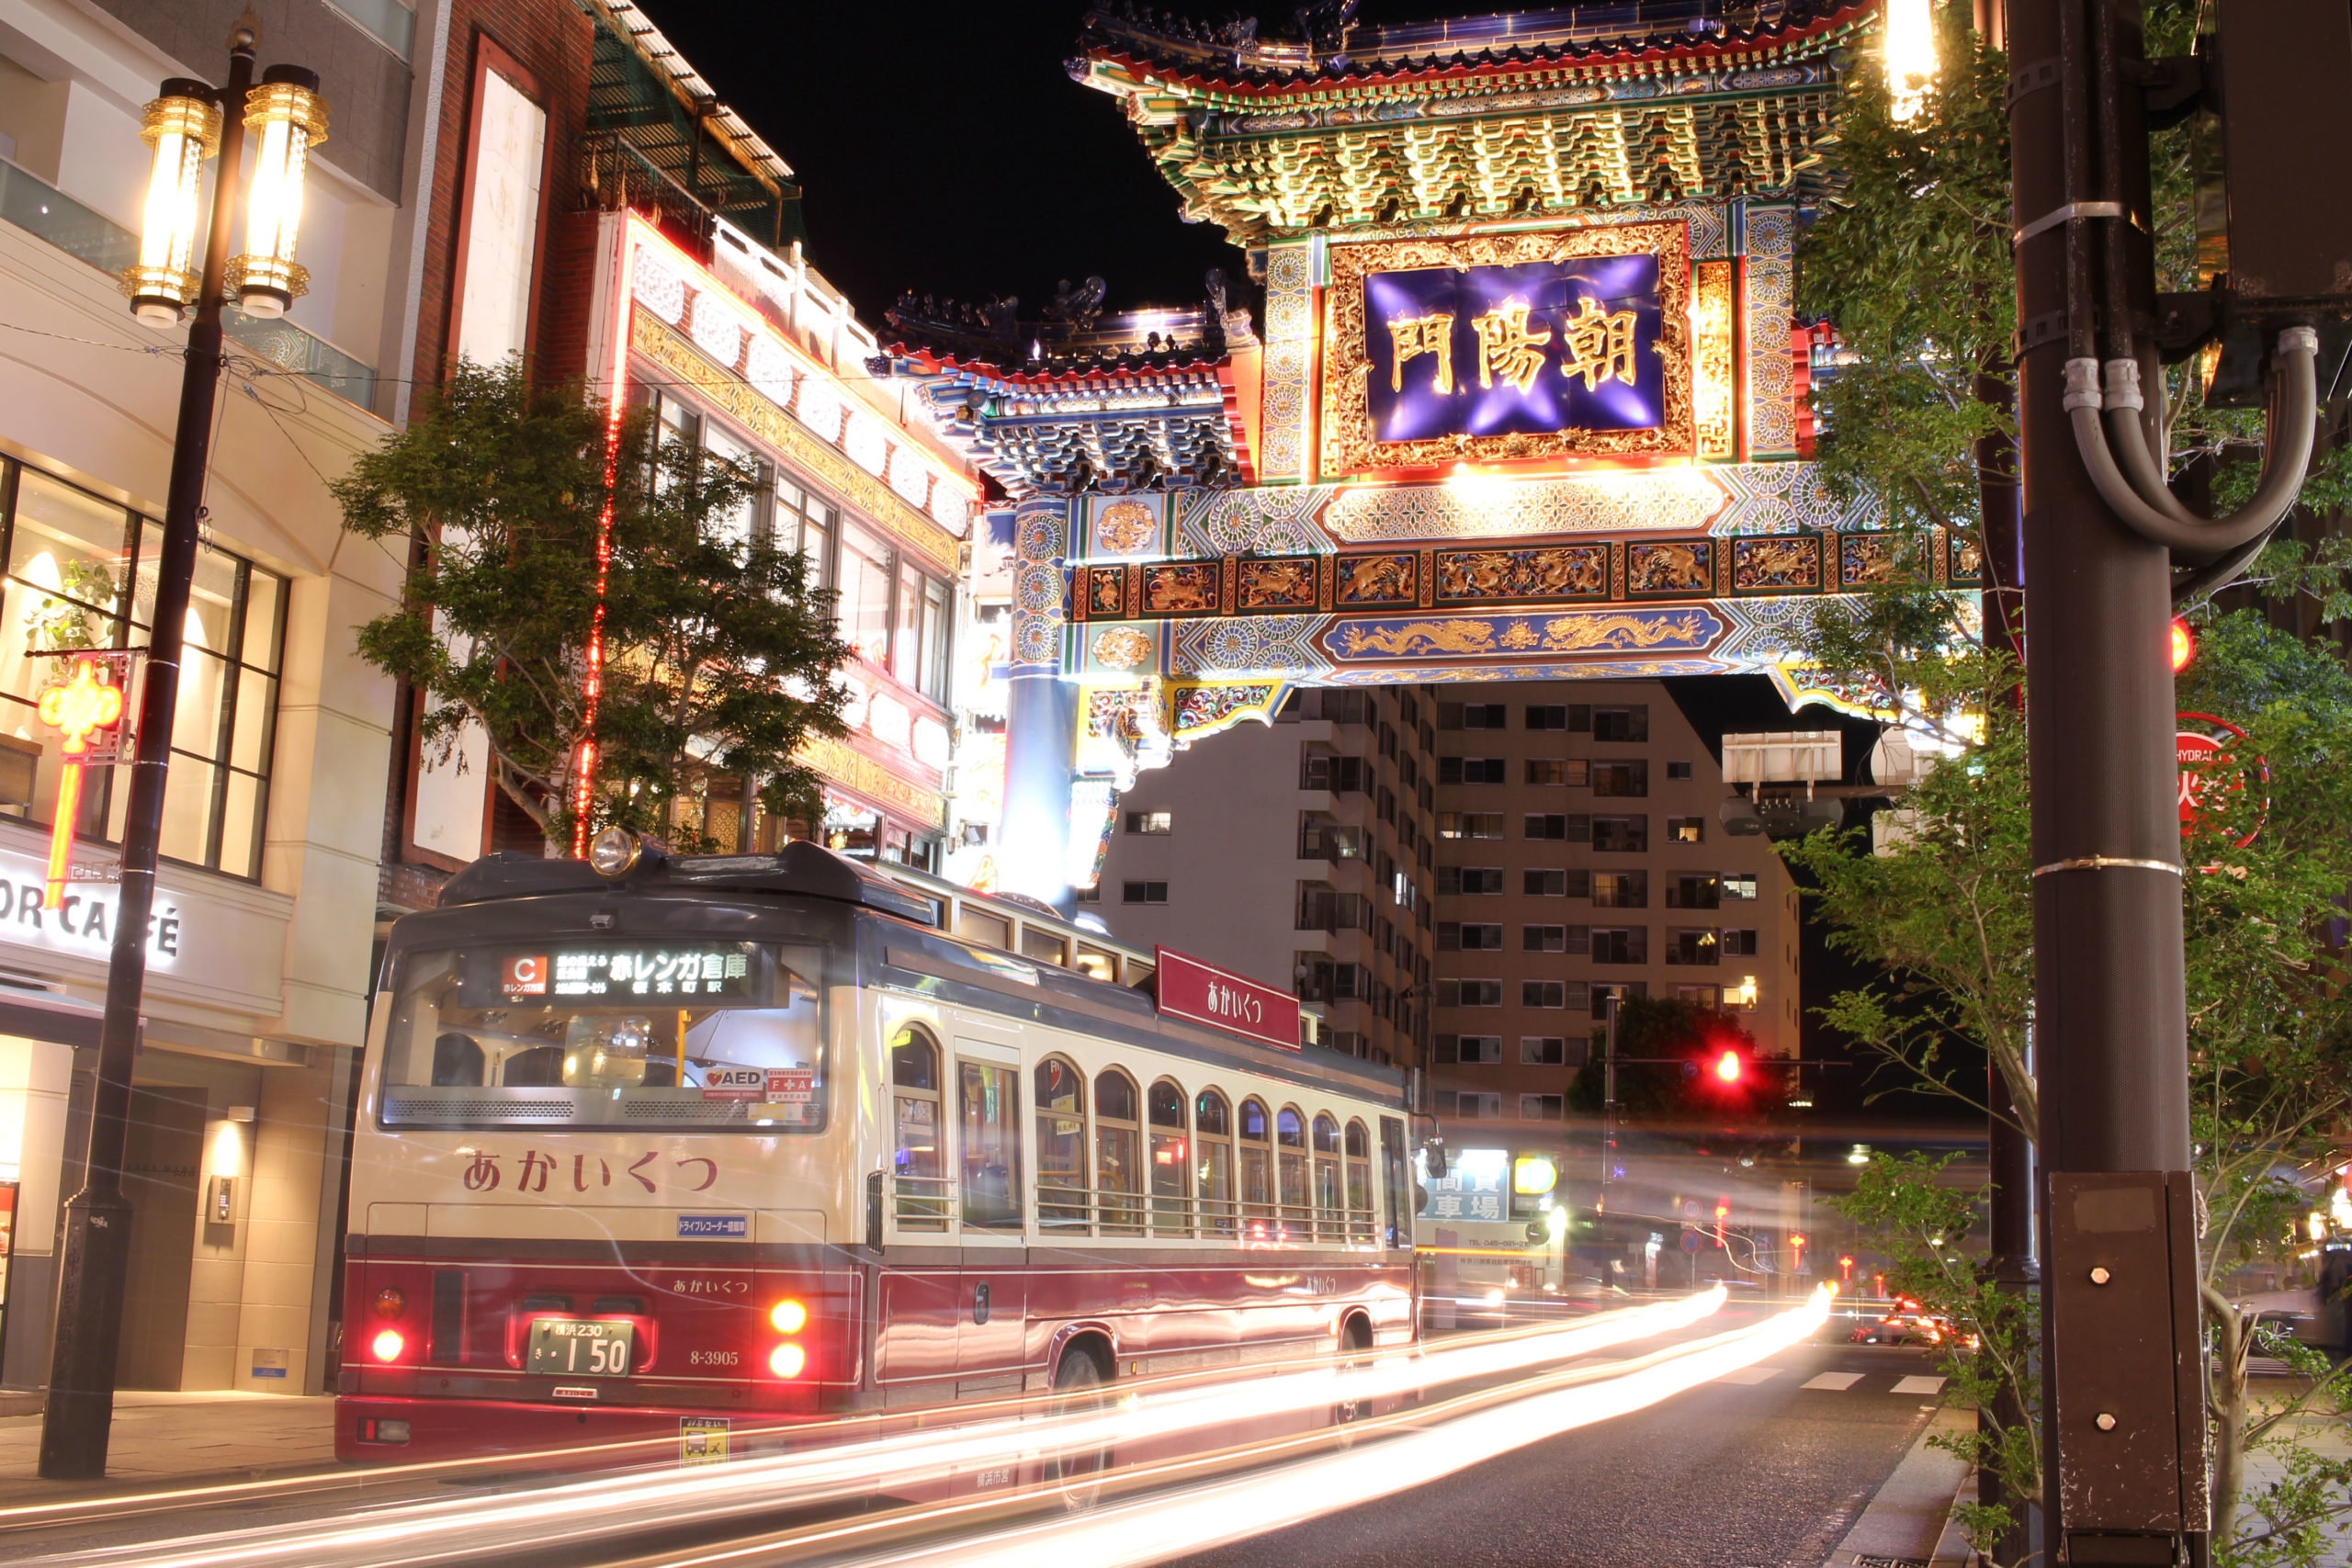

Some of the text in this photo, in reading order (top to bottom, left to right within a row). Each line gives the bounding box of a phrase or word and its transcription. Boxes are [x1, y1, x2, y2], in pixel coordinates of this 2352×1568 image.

[59, 894, 180, 957] CAÉ
[514, 958, 536, 982] C
[610, 953, 747, 981] 赤レンガ倉庫
[1206, 979, 1262, 1024] あかいくつ
[721, 1071, 761, 1085] AED
[463, 1149, 719, 1194] あかいくつ
[1418, 1194, 1500, 1220] 車場
[673, 1279, 749, 1293] あかいくつ
[534, 1348, 542, 1360] き
[690, 1350, 739, 1366] 8-3905
